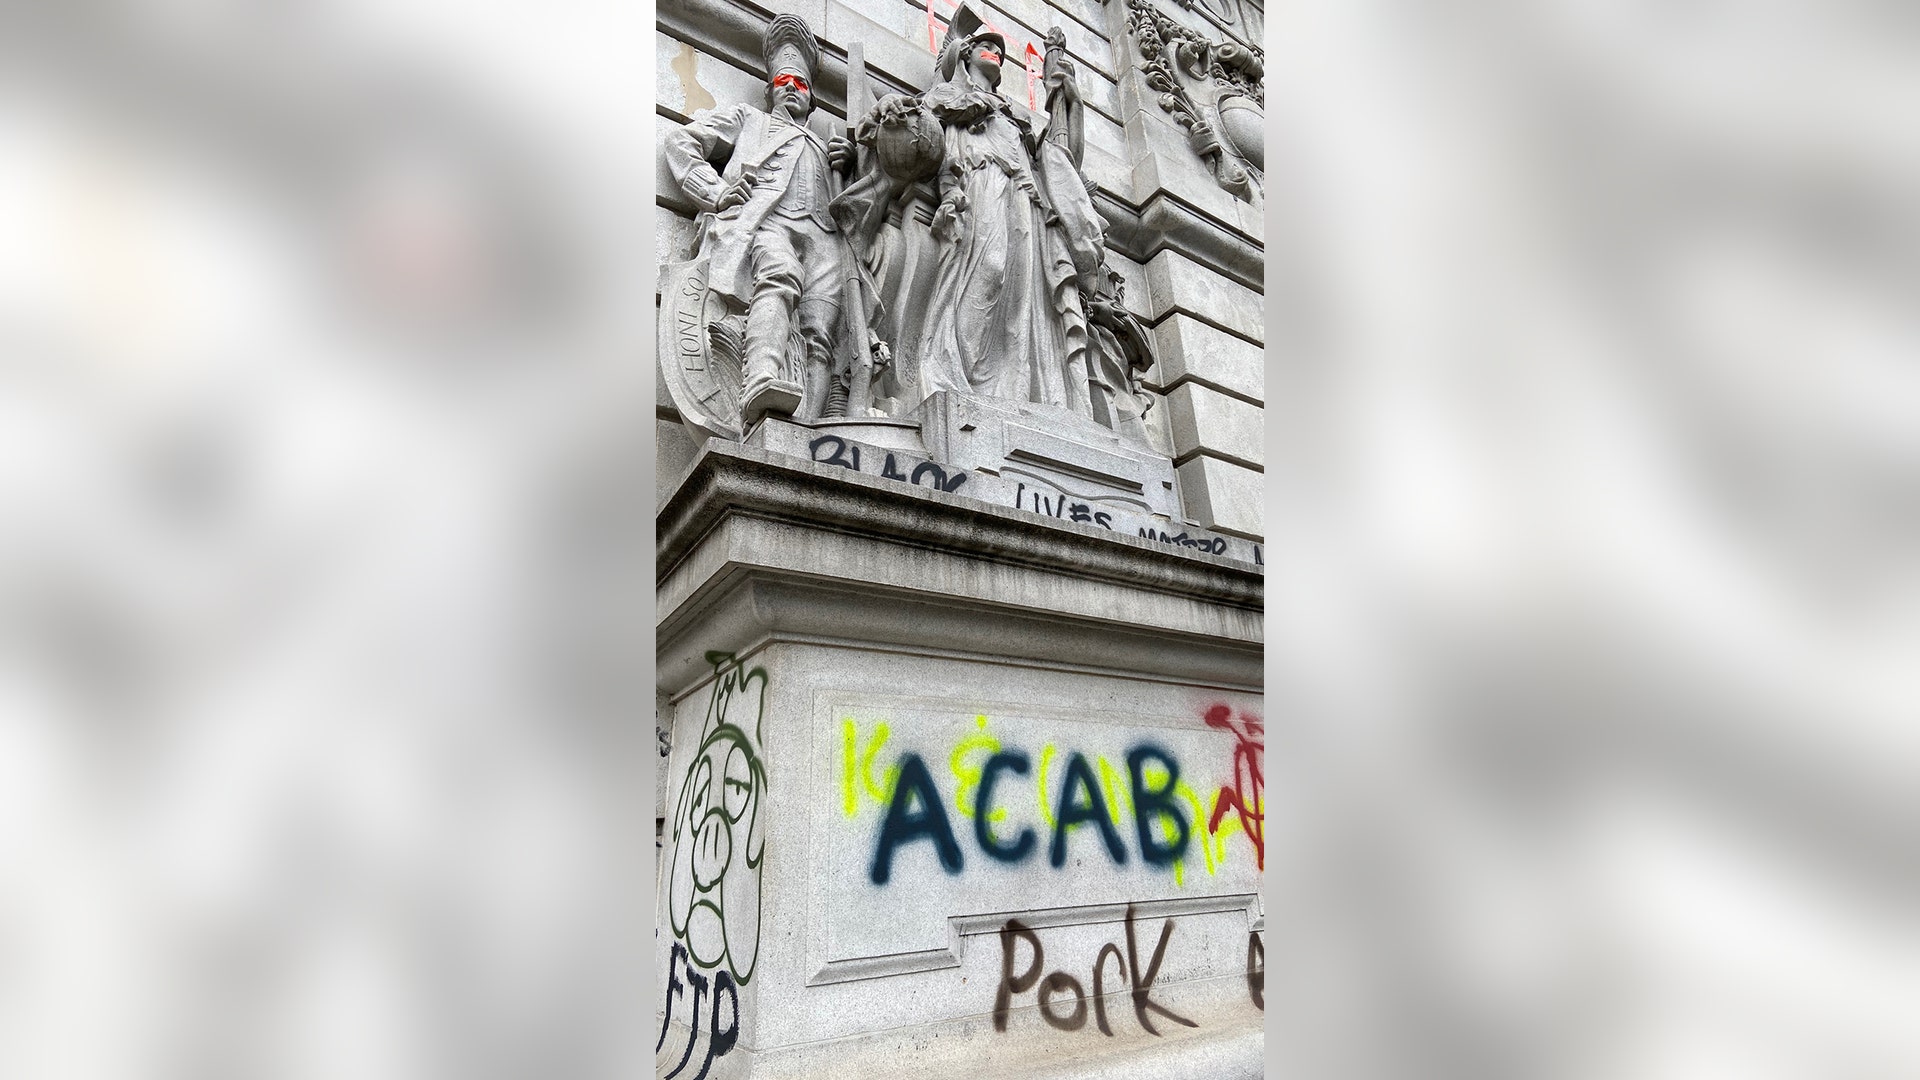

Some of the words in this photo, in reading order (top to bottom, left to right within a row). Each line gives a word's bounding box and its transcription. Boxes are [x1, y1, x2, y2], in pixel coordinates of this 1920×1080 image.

[679, 311, 704, 372] HONI
[870, 742, 1191, 886] ACAB
[656, 940, 739, 1080] FTP
